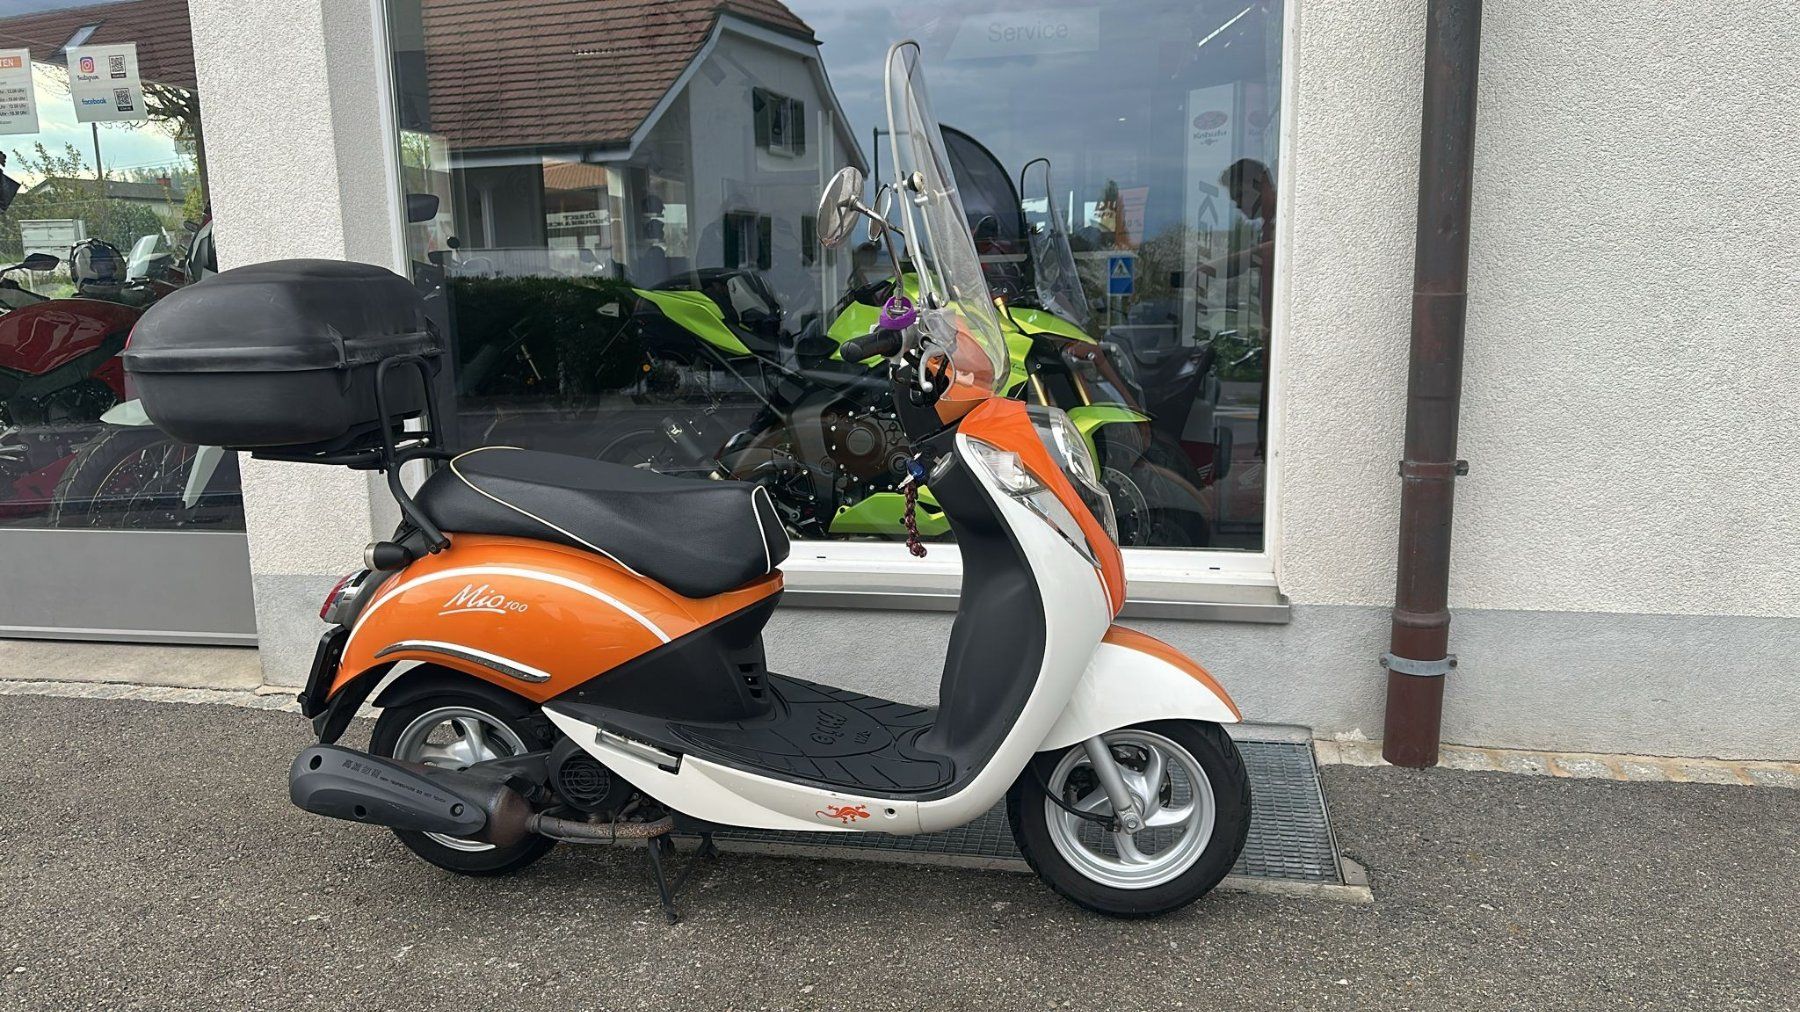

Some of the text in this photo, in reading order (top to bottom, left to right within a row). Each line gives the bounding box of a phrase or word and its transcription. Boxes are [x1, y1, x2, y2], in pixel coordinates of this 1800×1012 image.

[988, 21, 1068, 41] Service
[443, 583, 529, 613] Mio 100
